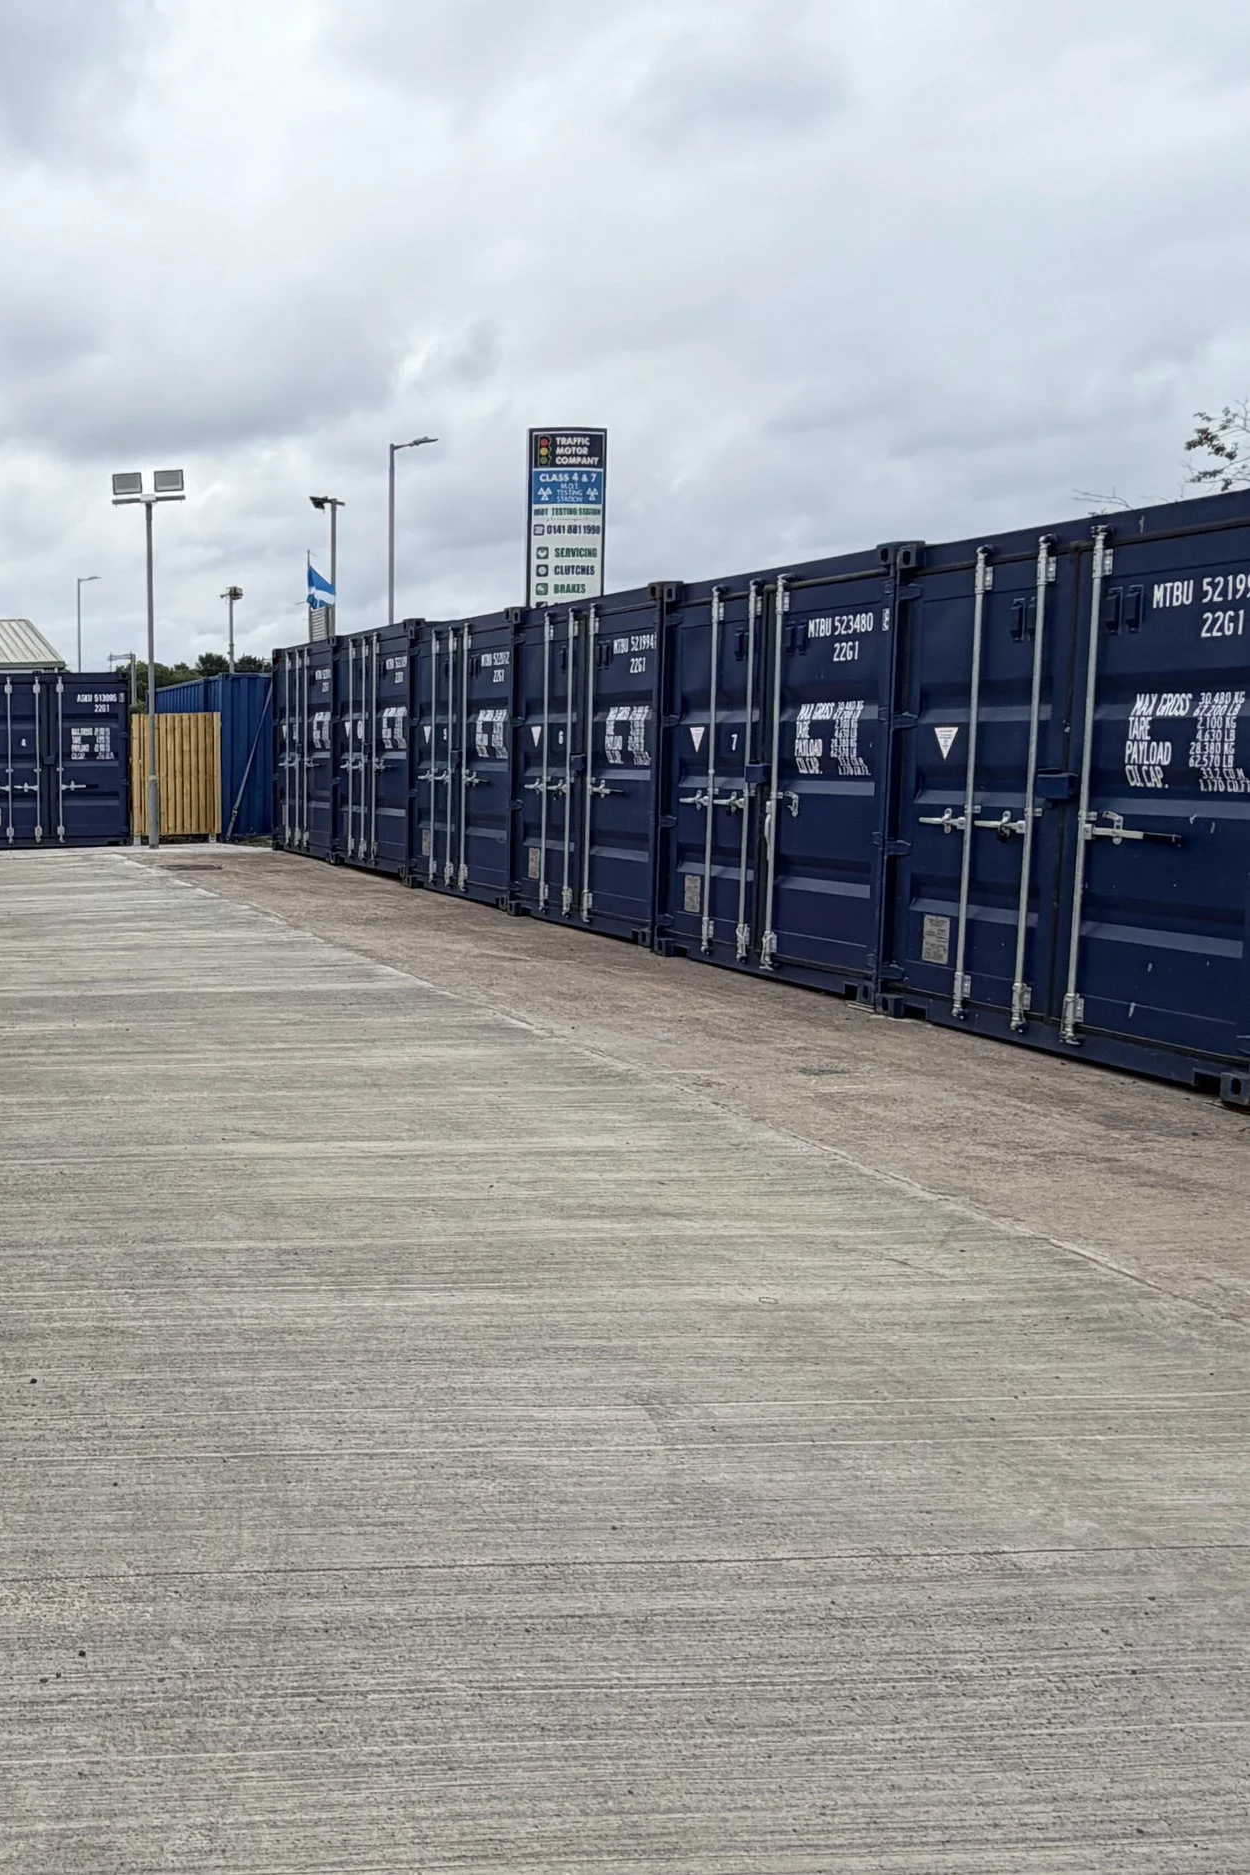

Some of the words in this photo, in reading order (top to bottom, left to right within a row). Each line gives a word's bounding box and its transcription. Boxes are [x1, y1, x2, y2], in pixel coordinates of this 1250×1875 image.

[556, 437, 590, 445] TRAFFIC
[556, 447, 588, 455] MOTOR
[555, 457, 599, 465] COMPANY
[539, 473, 570, 482] CLASS
[572, 472, 579, 482] 4
[581, 473, 588, 482] &
[591, 473, 597, 482] 7
[551, 507, 578, 516] TESTING
[547, 525, 565, 535] 0141
[554, 548, 597, 558] SERVICING
[554, 565, 595, 575] CLUTCHES
[554, 584, 586, 594] BRAKES
[1153, 579, 1194, 608] MTBU
[808, 617, 832, 638] MTBU
[834, 612, 874, 635] 523480
[1201, 609, 1244, 637] 22G1
[833, 640, 859, 662] 22G1
[630, 657, 646, 673] 22G1
[812, 702, 835, 720] GROSS
[1131, 693, 1158, 716] MAX
[1155, 693, 1193, 717] GROSS
[1232, 691, 1246, 704] KG
[1227, 704, 1241, 716] LB
[796, 720, 810, 738] TARE
[1128, 717, 1152, 739] TARE
[1225, 717, 1237, 729] KG
[1224, 729, 1236, 741] LB
[730, 733, 738, 751] 7
[794, 739, 822, 757] PAYLOAD
[1125, 740, 1172, 766] PAYLOAD
[1223, 742, 1235, 754] KG
[1223, 755, 1234, 768] LB
